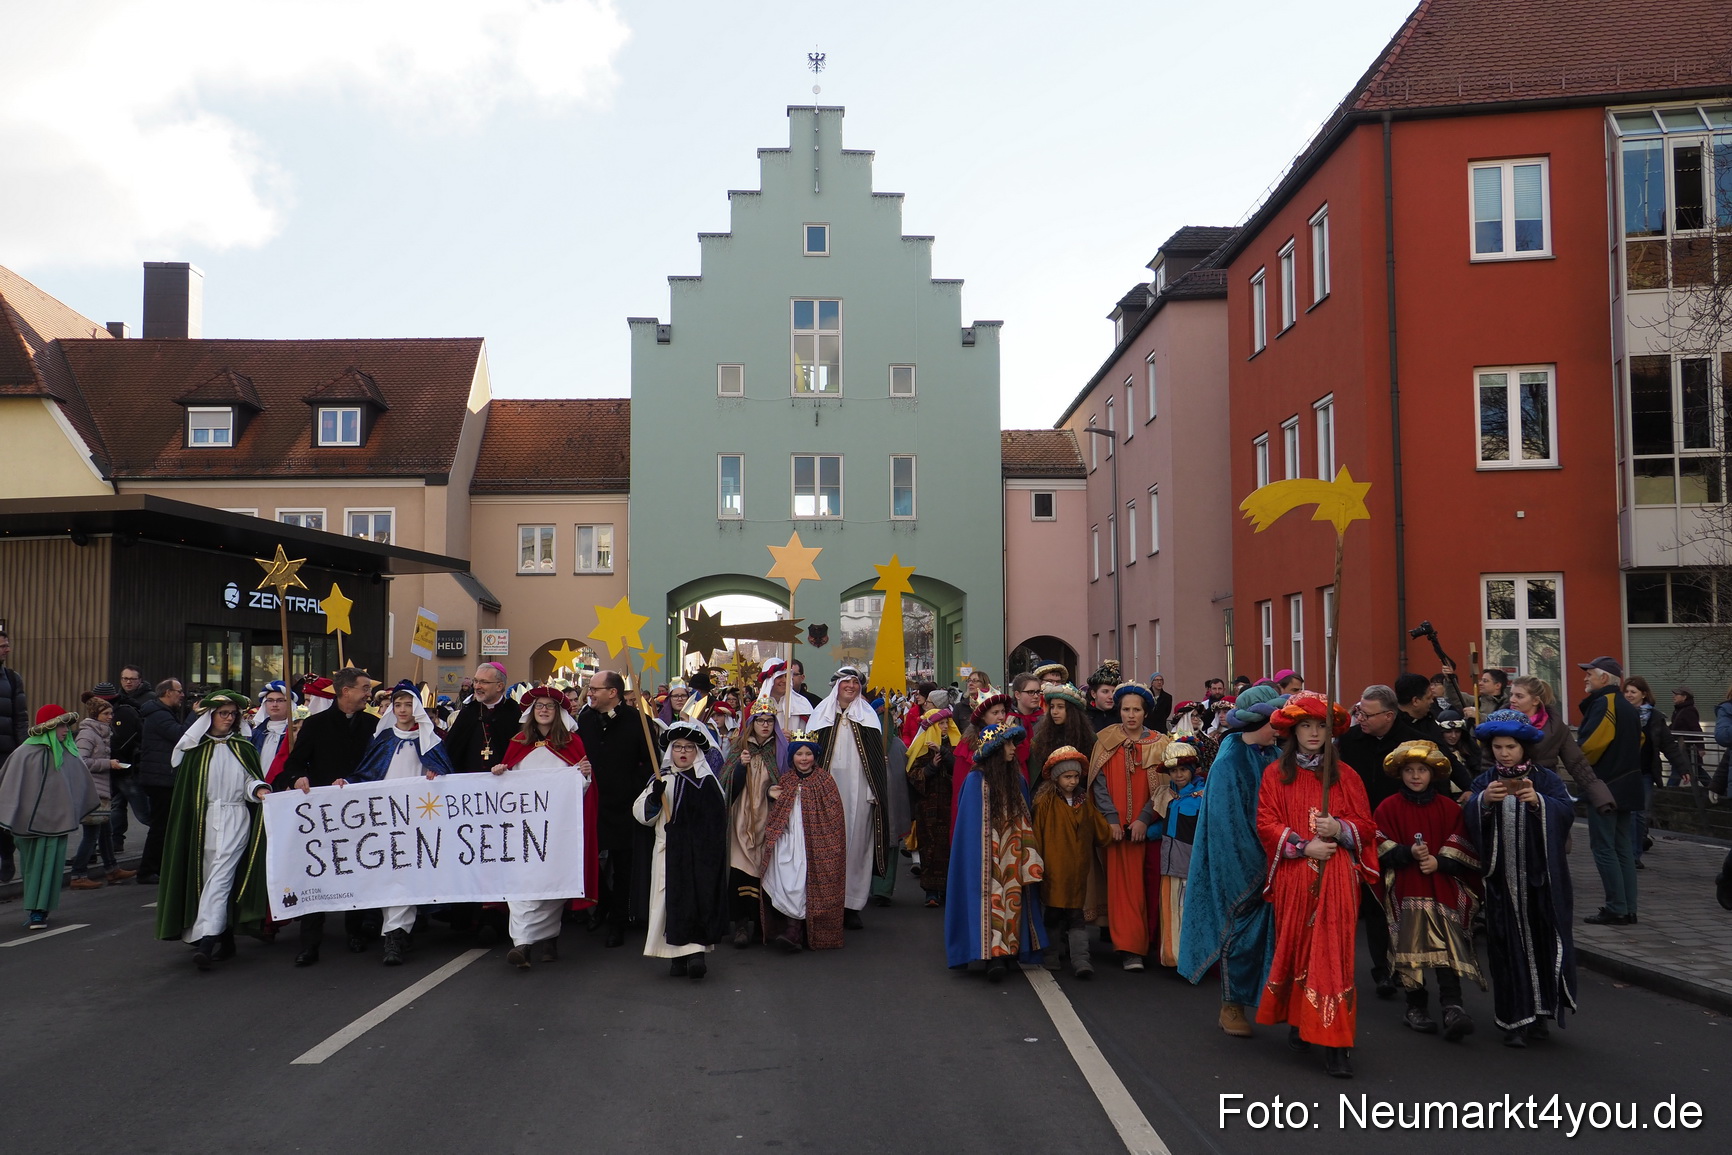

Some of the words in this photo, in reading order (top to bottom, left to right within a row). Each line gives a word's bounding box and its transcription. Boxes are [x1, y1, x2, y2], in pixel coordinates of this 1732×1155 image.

[249, 591, 328, 615] ZENTRAL
[295, 794, 410, 834] SEGEN
[445, 790, 548, 819] BRINGEN
[306, 826, 441, 877] SEGEN
[457, 819, 548, 865] SEIN
[301, 888, 322, 896] AKTION
